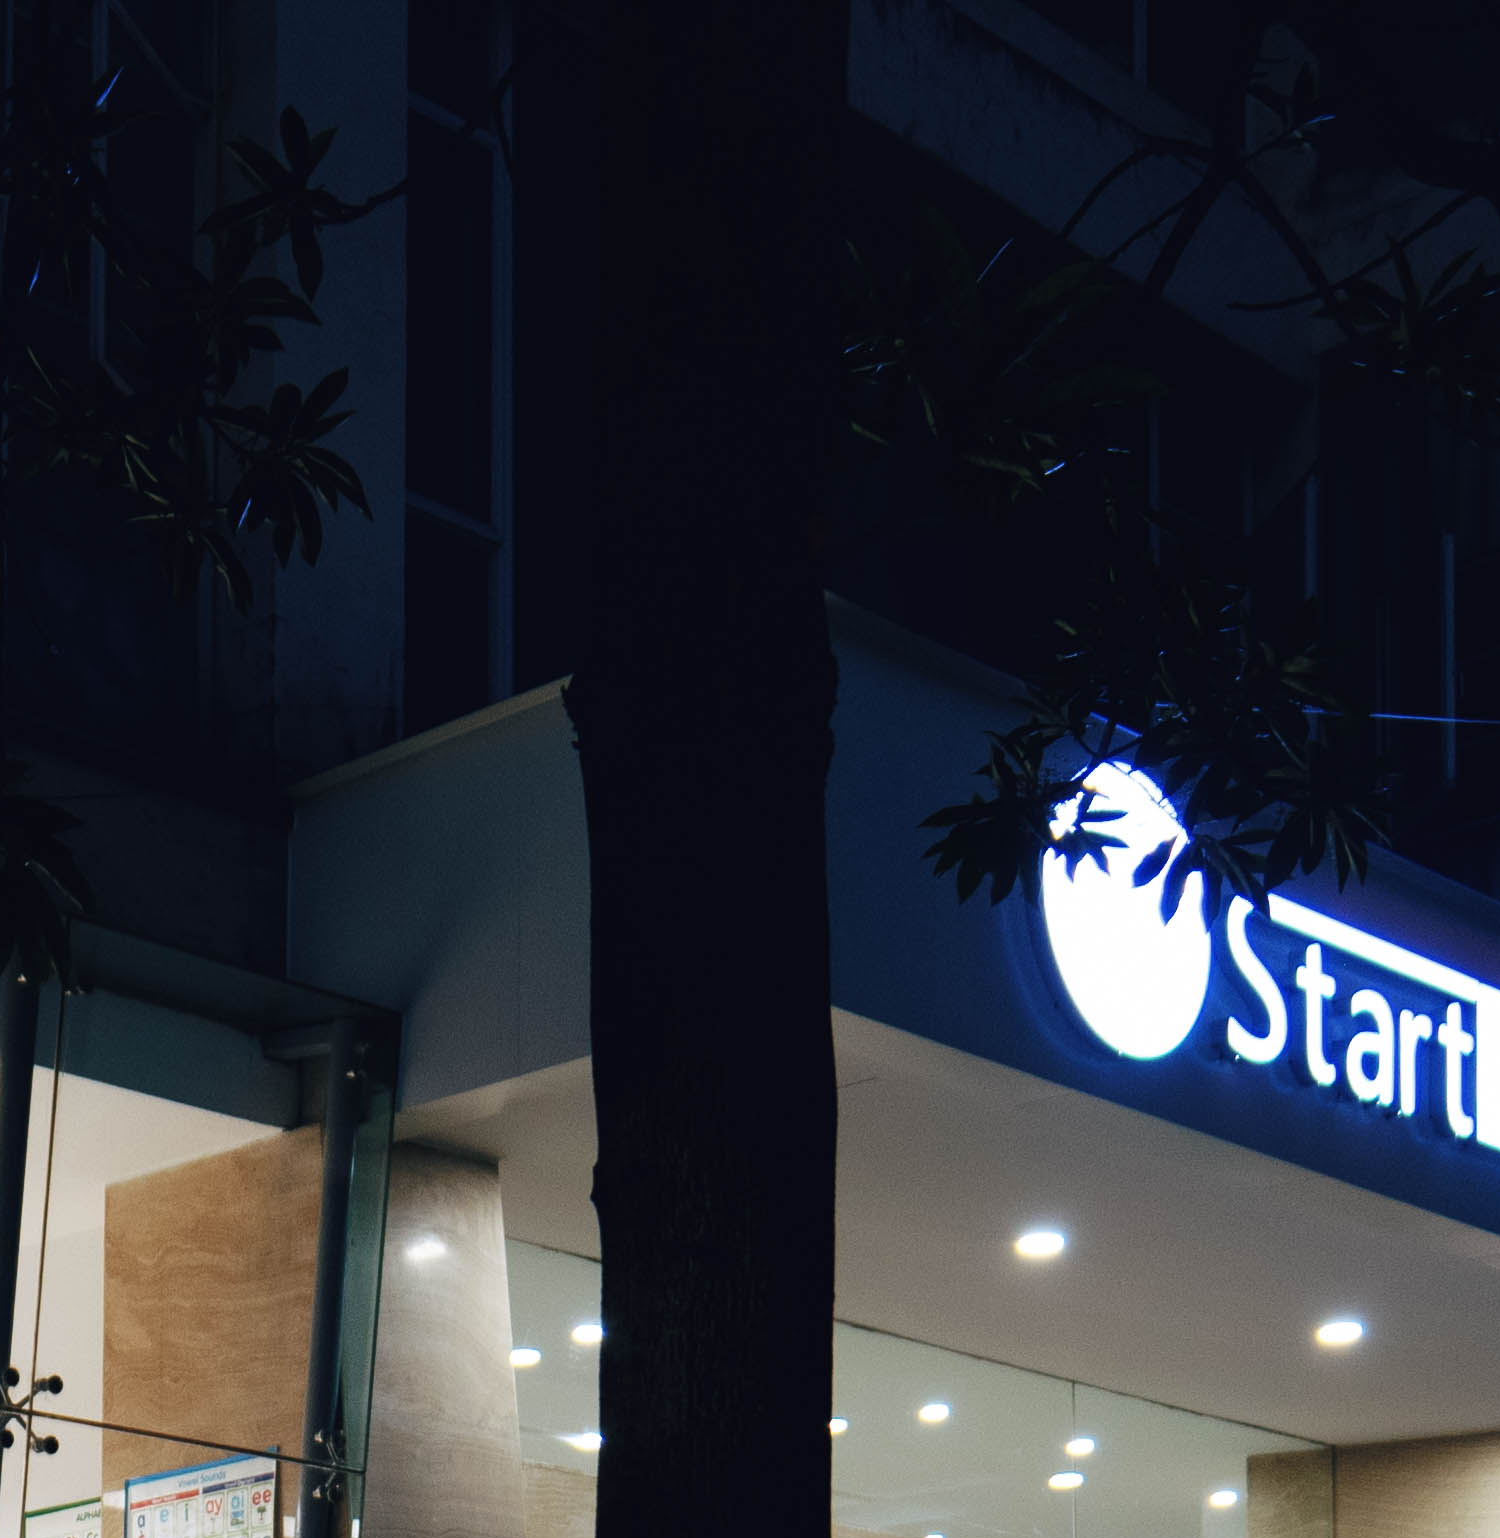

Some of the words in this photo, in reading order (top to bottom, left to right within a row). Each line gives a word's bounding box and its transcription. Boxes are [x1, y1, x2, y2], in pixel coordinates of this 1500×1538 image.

[1226, 893, 1476, 1139] Start
[206, 1498, 223, 1516] ay
[252, 1489, 272, 1505] ee
